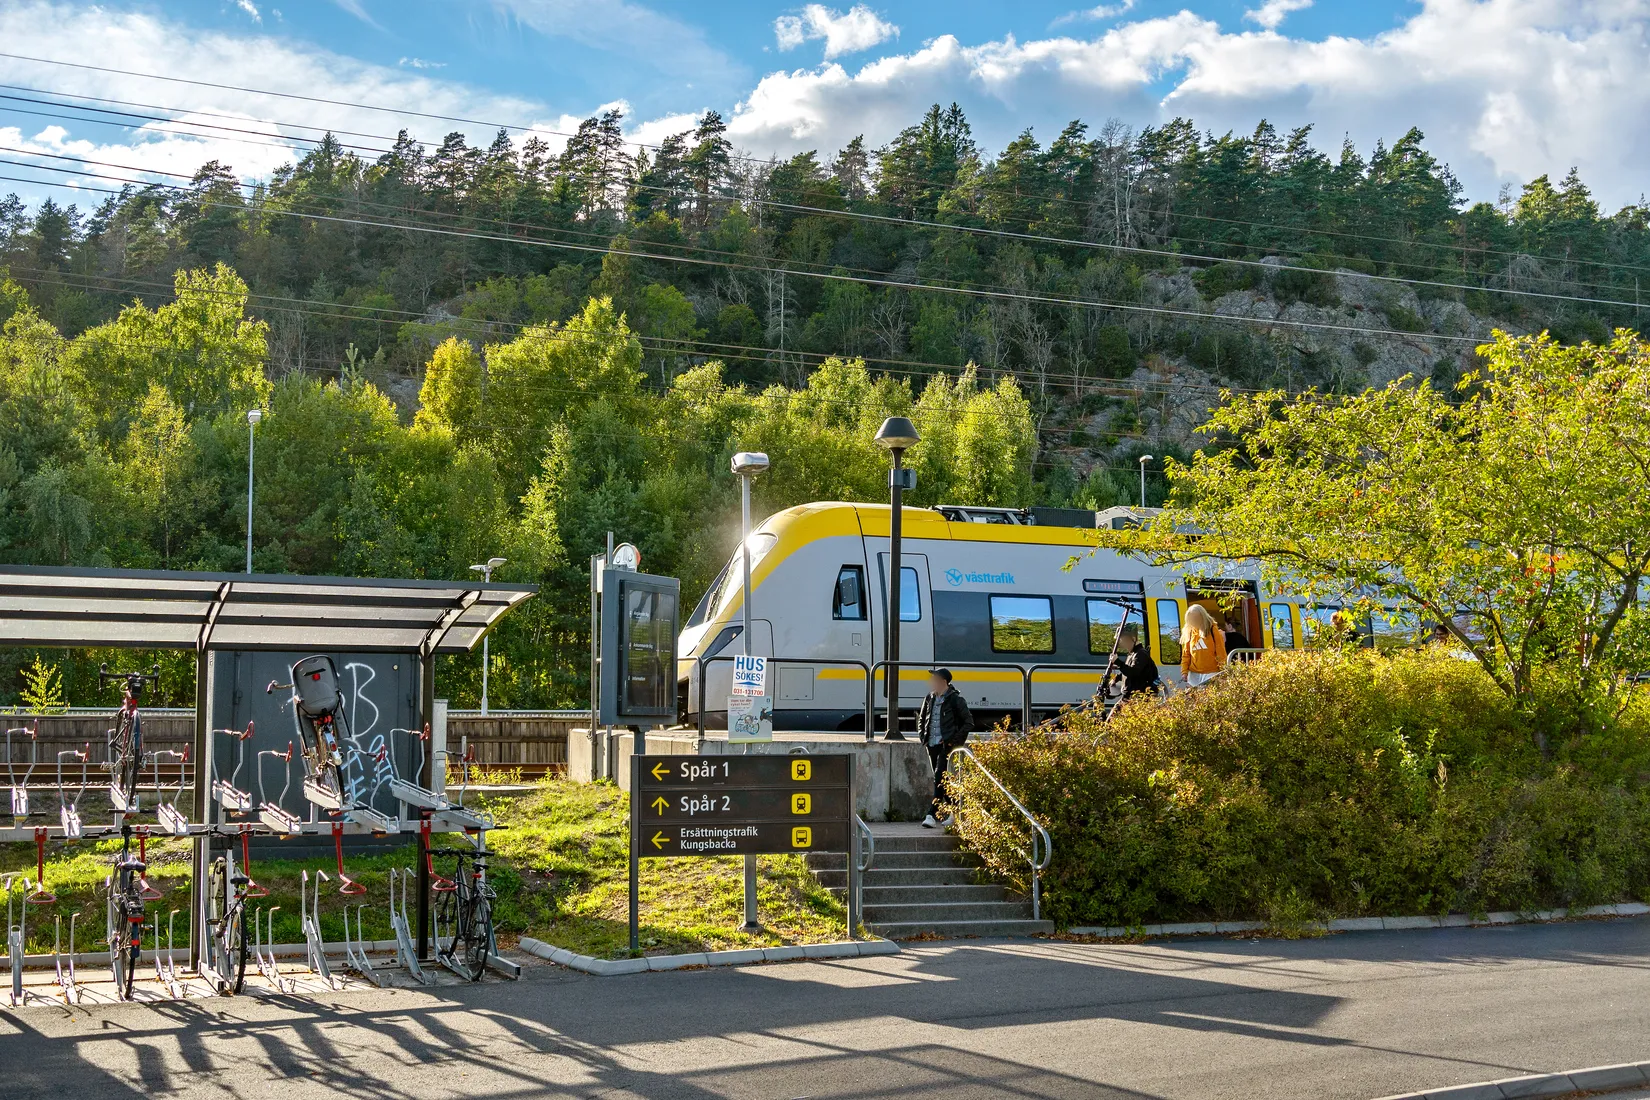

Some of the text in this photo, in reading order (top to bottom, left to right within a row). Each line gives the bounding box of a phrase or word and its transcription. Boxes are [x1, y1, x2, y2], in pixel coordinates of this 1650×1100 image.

[965, 572, 1015, 584] västtrafik
[736, 656, 764, 671] HUS
[735, 671, 764, 682] SÖKES!
[680, 760, 729, 782] Spår 1
[680, 794, 731, 816] Spår 2
[680, 826, 759, 839] Ersättningstrafik
[680, 839, 737, 852] Kungsbacka
